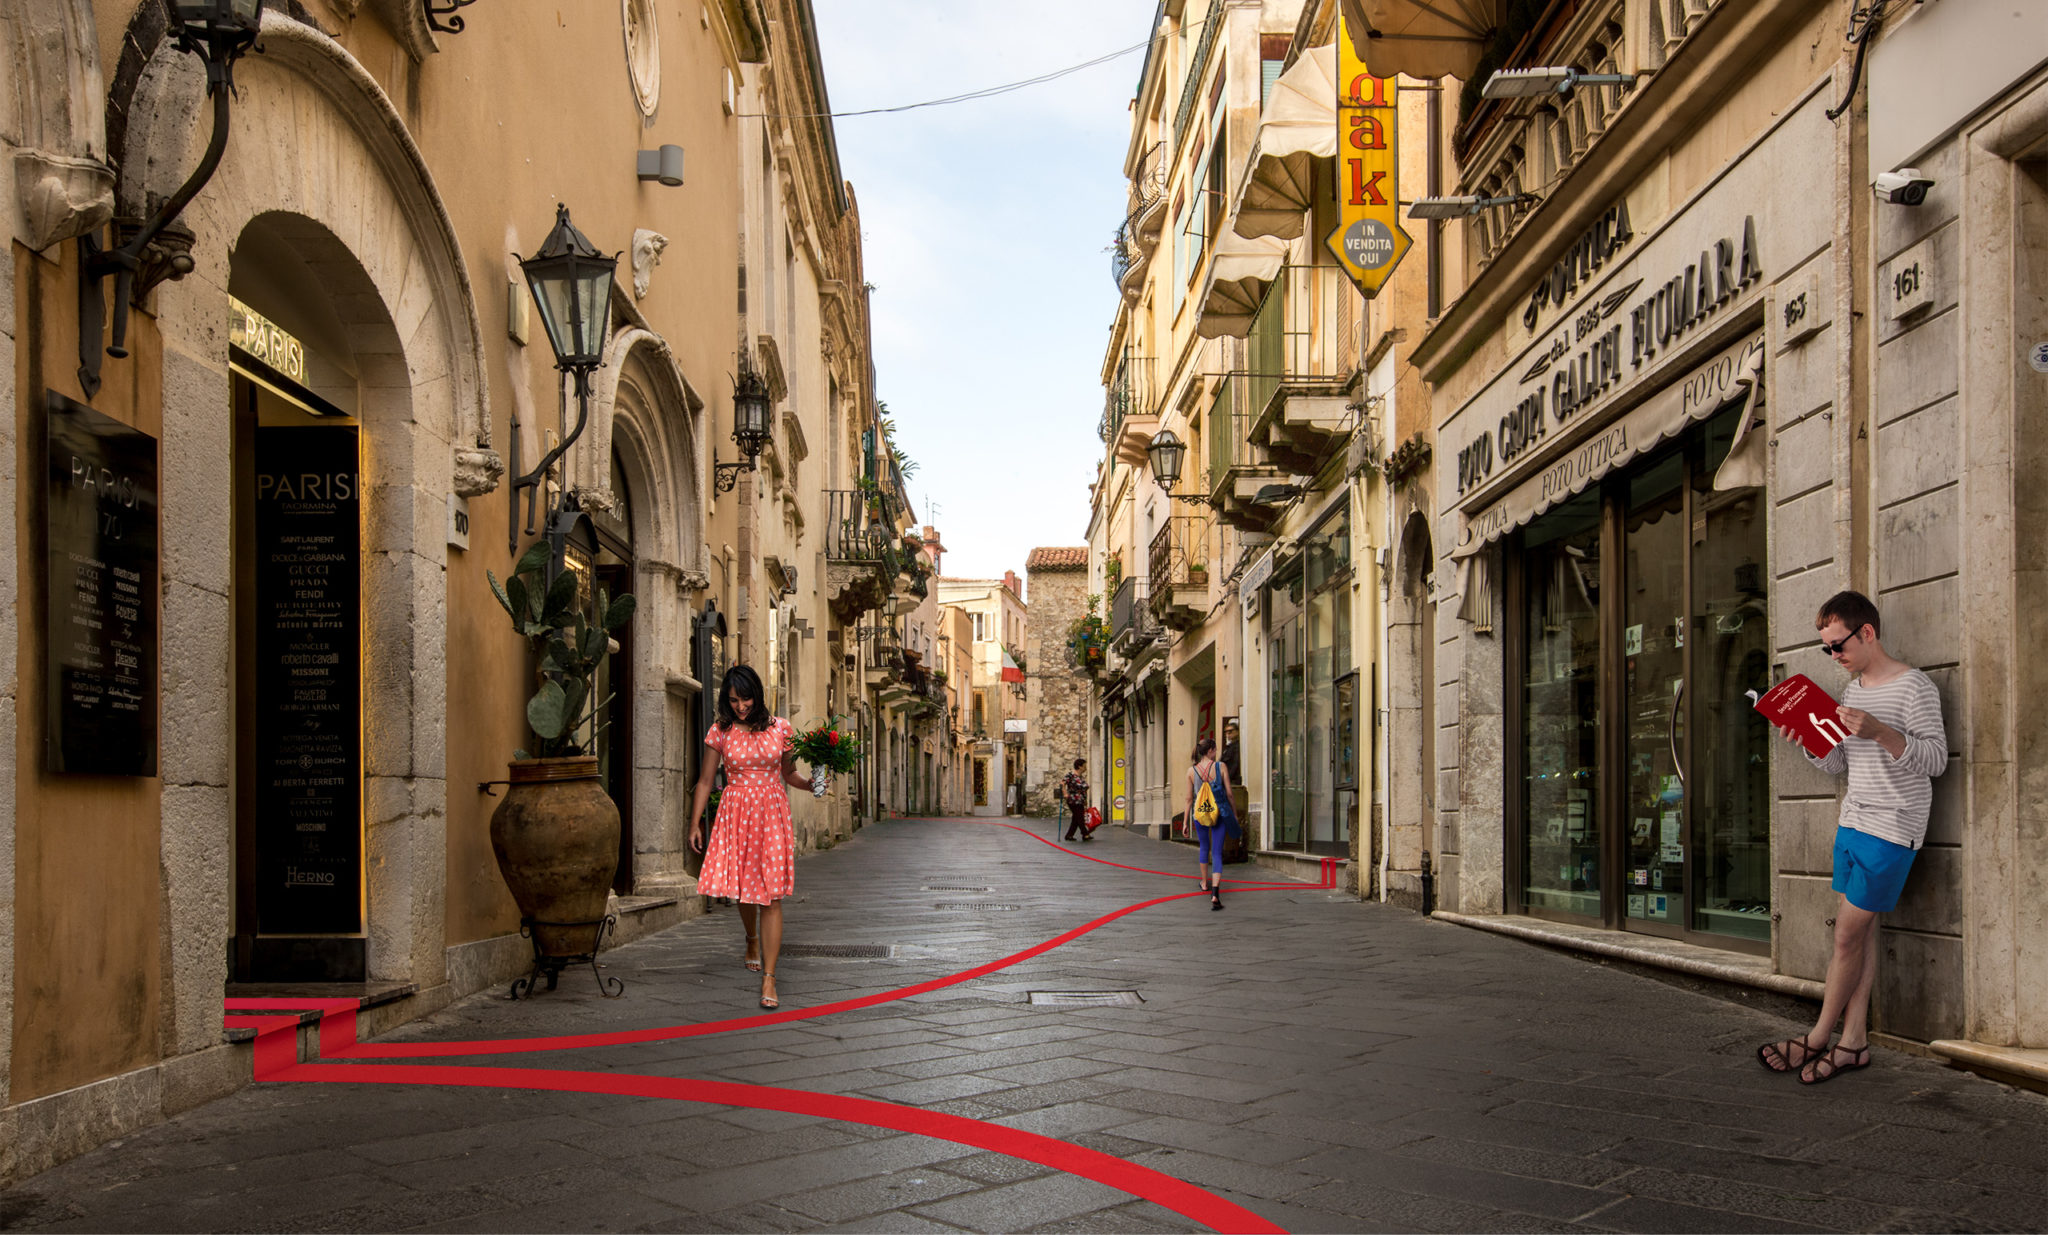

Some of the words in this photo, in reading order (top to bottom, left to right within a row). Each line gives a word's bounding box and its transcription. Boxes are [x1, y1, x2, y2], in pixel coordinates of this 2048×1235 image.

[1362, 225, 1375, 236] IN
[1346, 238, 1392, 251] VENDITA
[1359, 252, 1379, 265] QUI
[1894, 262, 1920, 300] 161
[1784, 292, 1806, 328] 163
[246, 314, 304, 379] PARISI
[1551, 329, 1570, 362] dal
[1457, 430, 1493, 493] FOTO
[1498, 385, 1546, 461] CRUPI
[1552, 324, 1622, 422] GALIFI
[1630, 215, 1762, 365] FIUMARA
[1682, 356, 1731, 415] FOTO
[1541, 459, 1574, 500] FOTO
[1578, 424, 1628, 478] OTTICA
[72, 455, 140, 511] PARISI
[257, 473, 359, 500] PARISI
[302, 536, 335, 545] LAURENT
[288, 565, 328, 575] GUCCI
[289, 578, 328, 587] PRADA
[79, 591, 97, 604] FENDI
[295, 590, 324, 599] FENDI
[281, 653, 311, 664] roberto
[312, 652, 339, 664] cavalli
[291, 668, 328, 676] MISSONI
[314, 757, 346, 765] BURCH
[309, 777, 344, 785] FERRETTI
